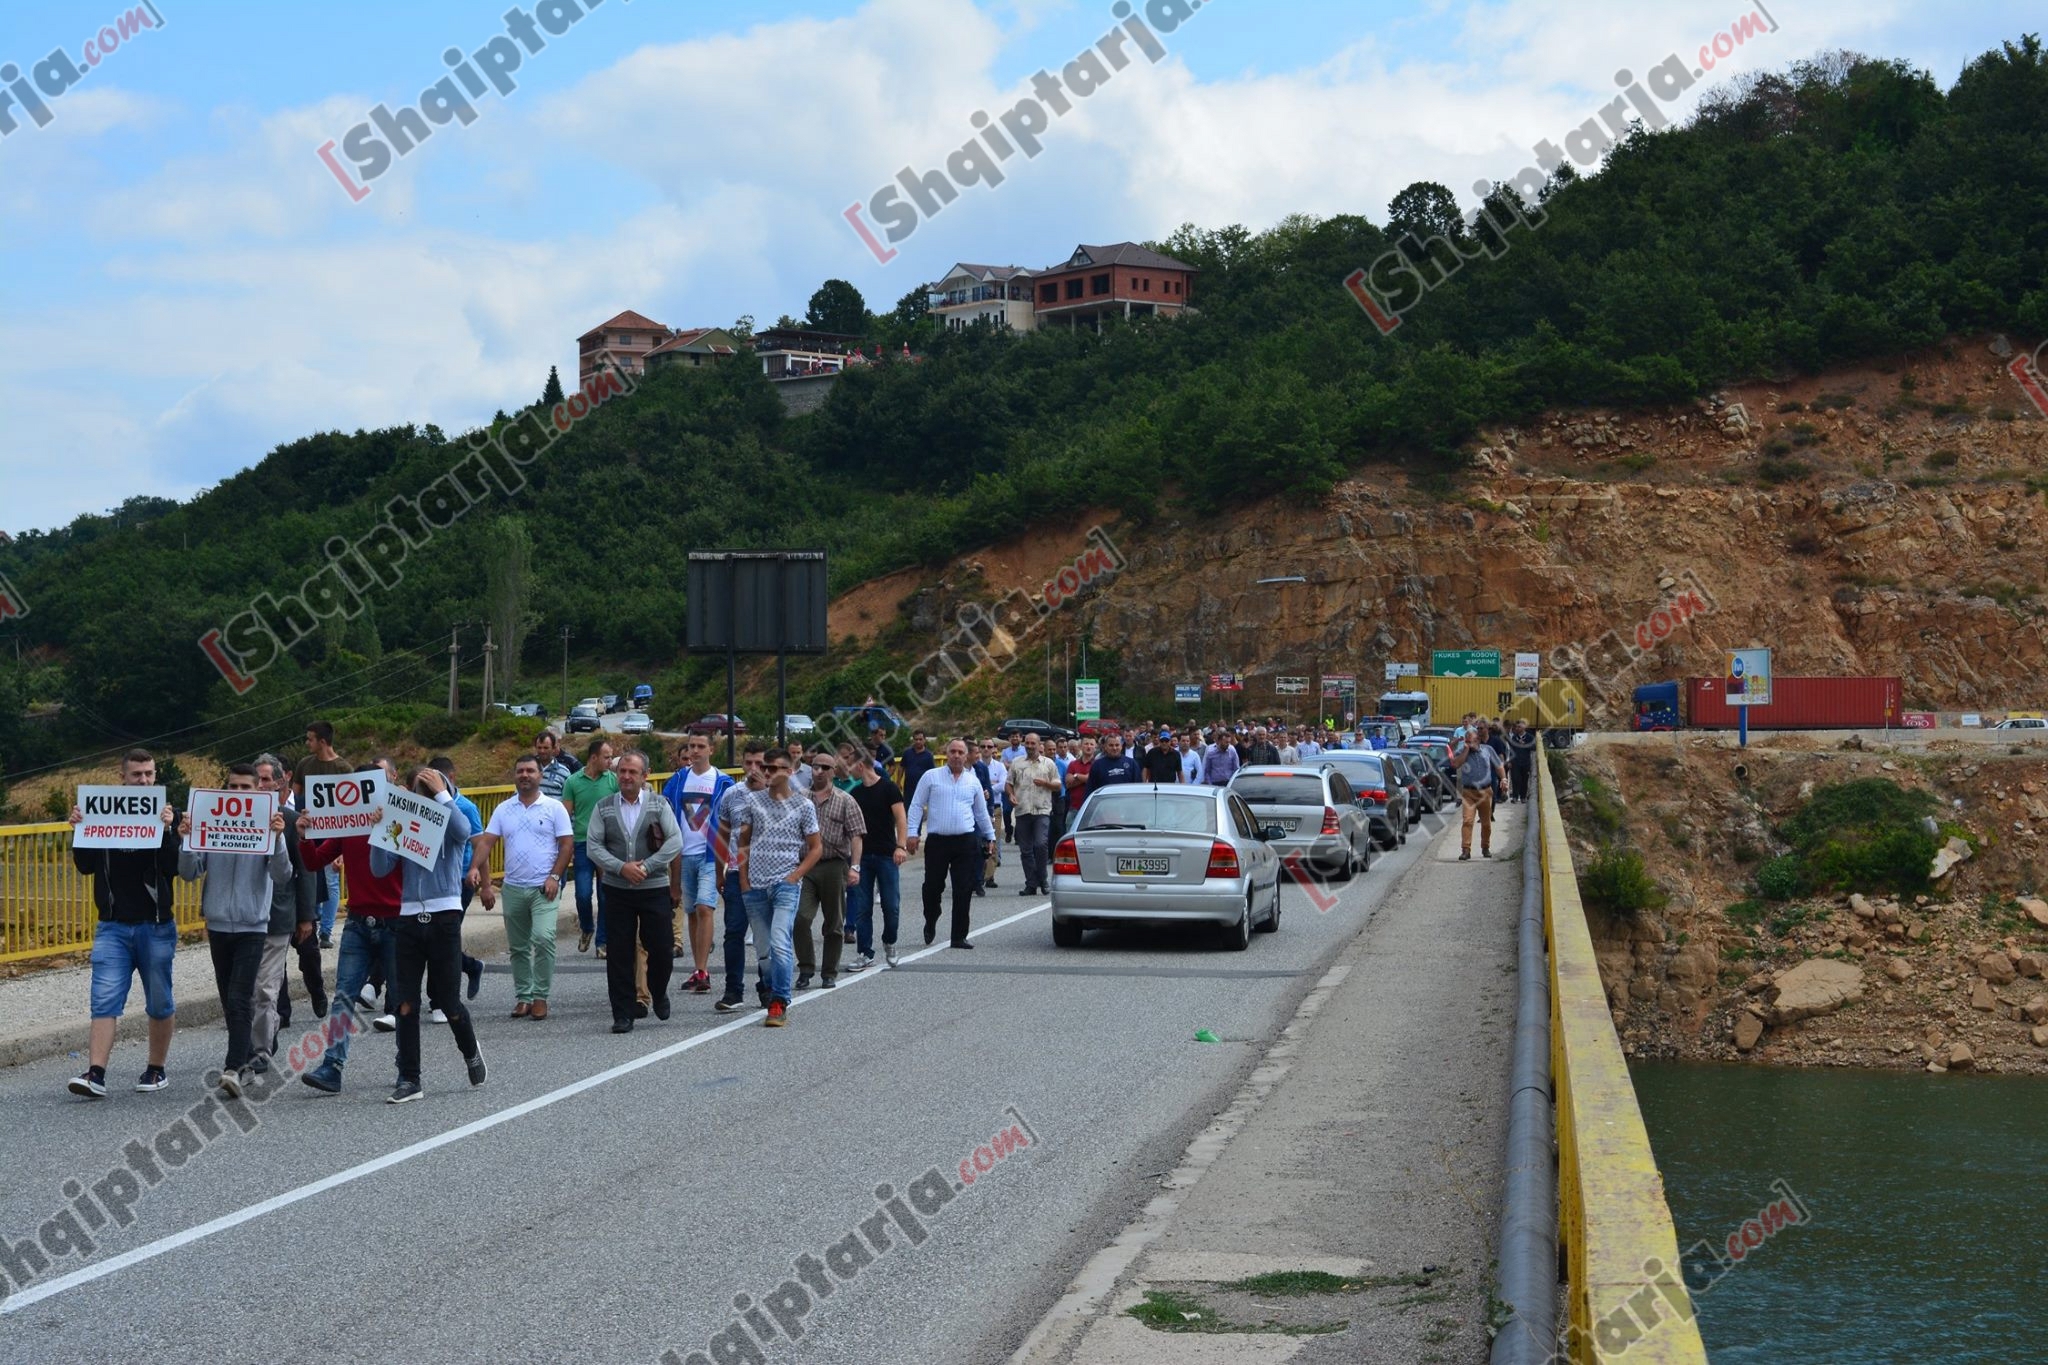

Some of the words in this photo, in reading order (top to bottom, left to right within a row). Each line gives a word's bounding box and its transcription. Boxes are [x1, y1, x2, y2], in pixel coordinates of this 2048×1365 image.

[312, 779, 376, 808] STOP
[387, 792, 419, 815] TAKSIMI
[85, 796, 157, 815] KUKESI
[210, 797, 253, 817] JO!
[83, 825, 156, 838] #PROTESTON
[402, 835, 431, 859] VJEDHJE
